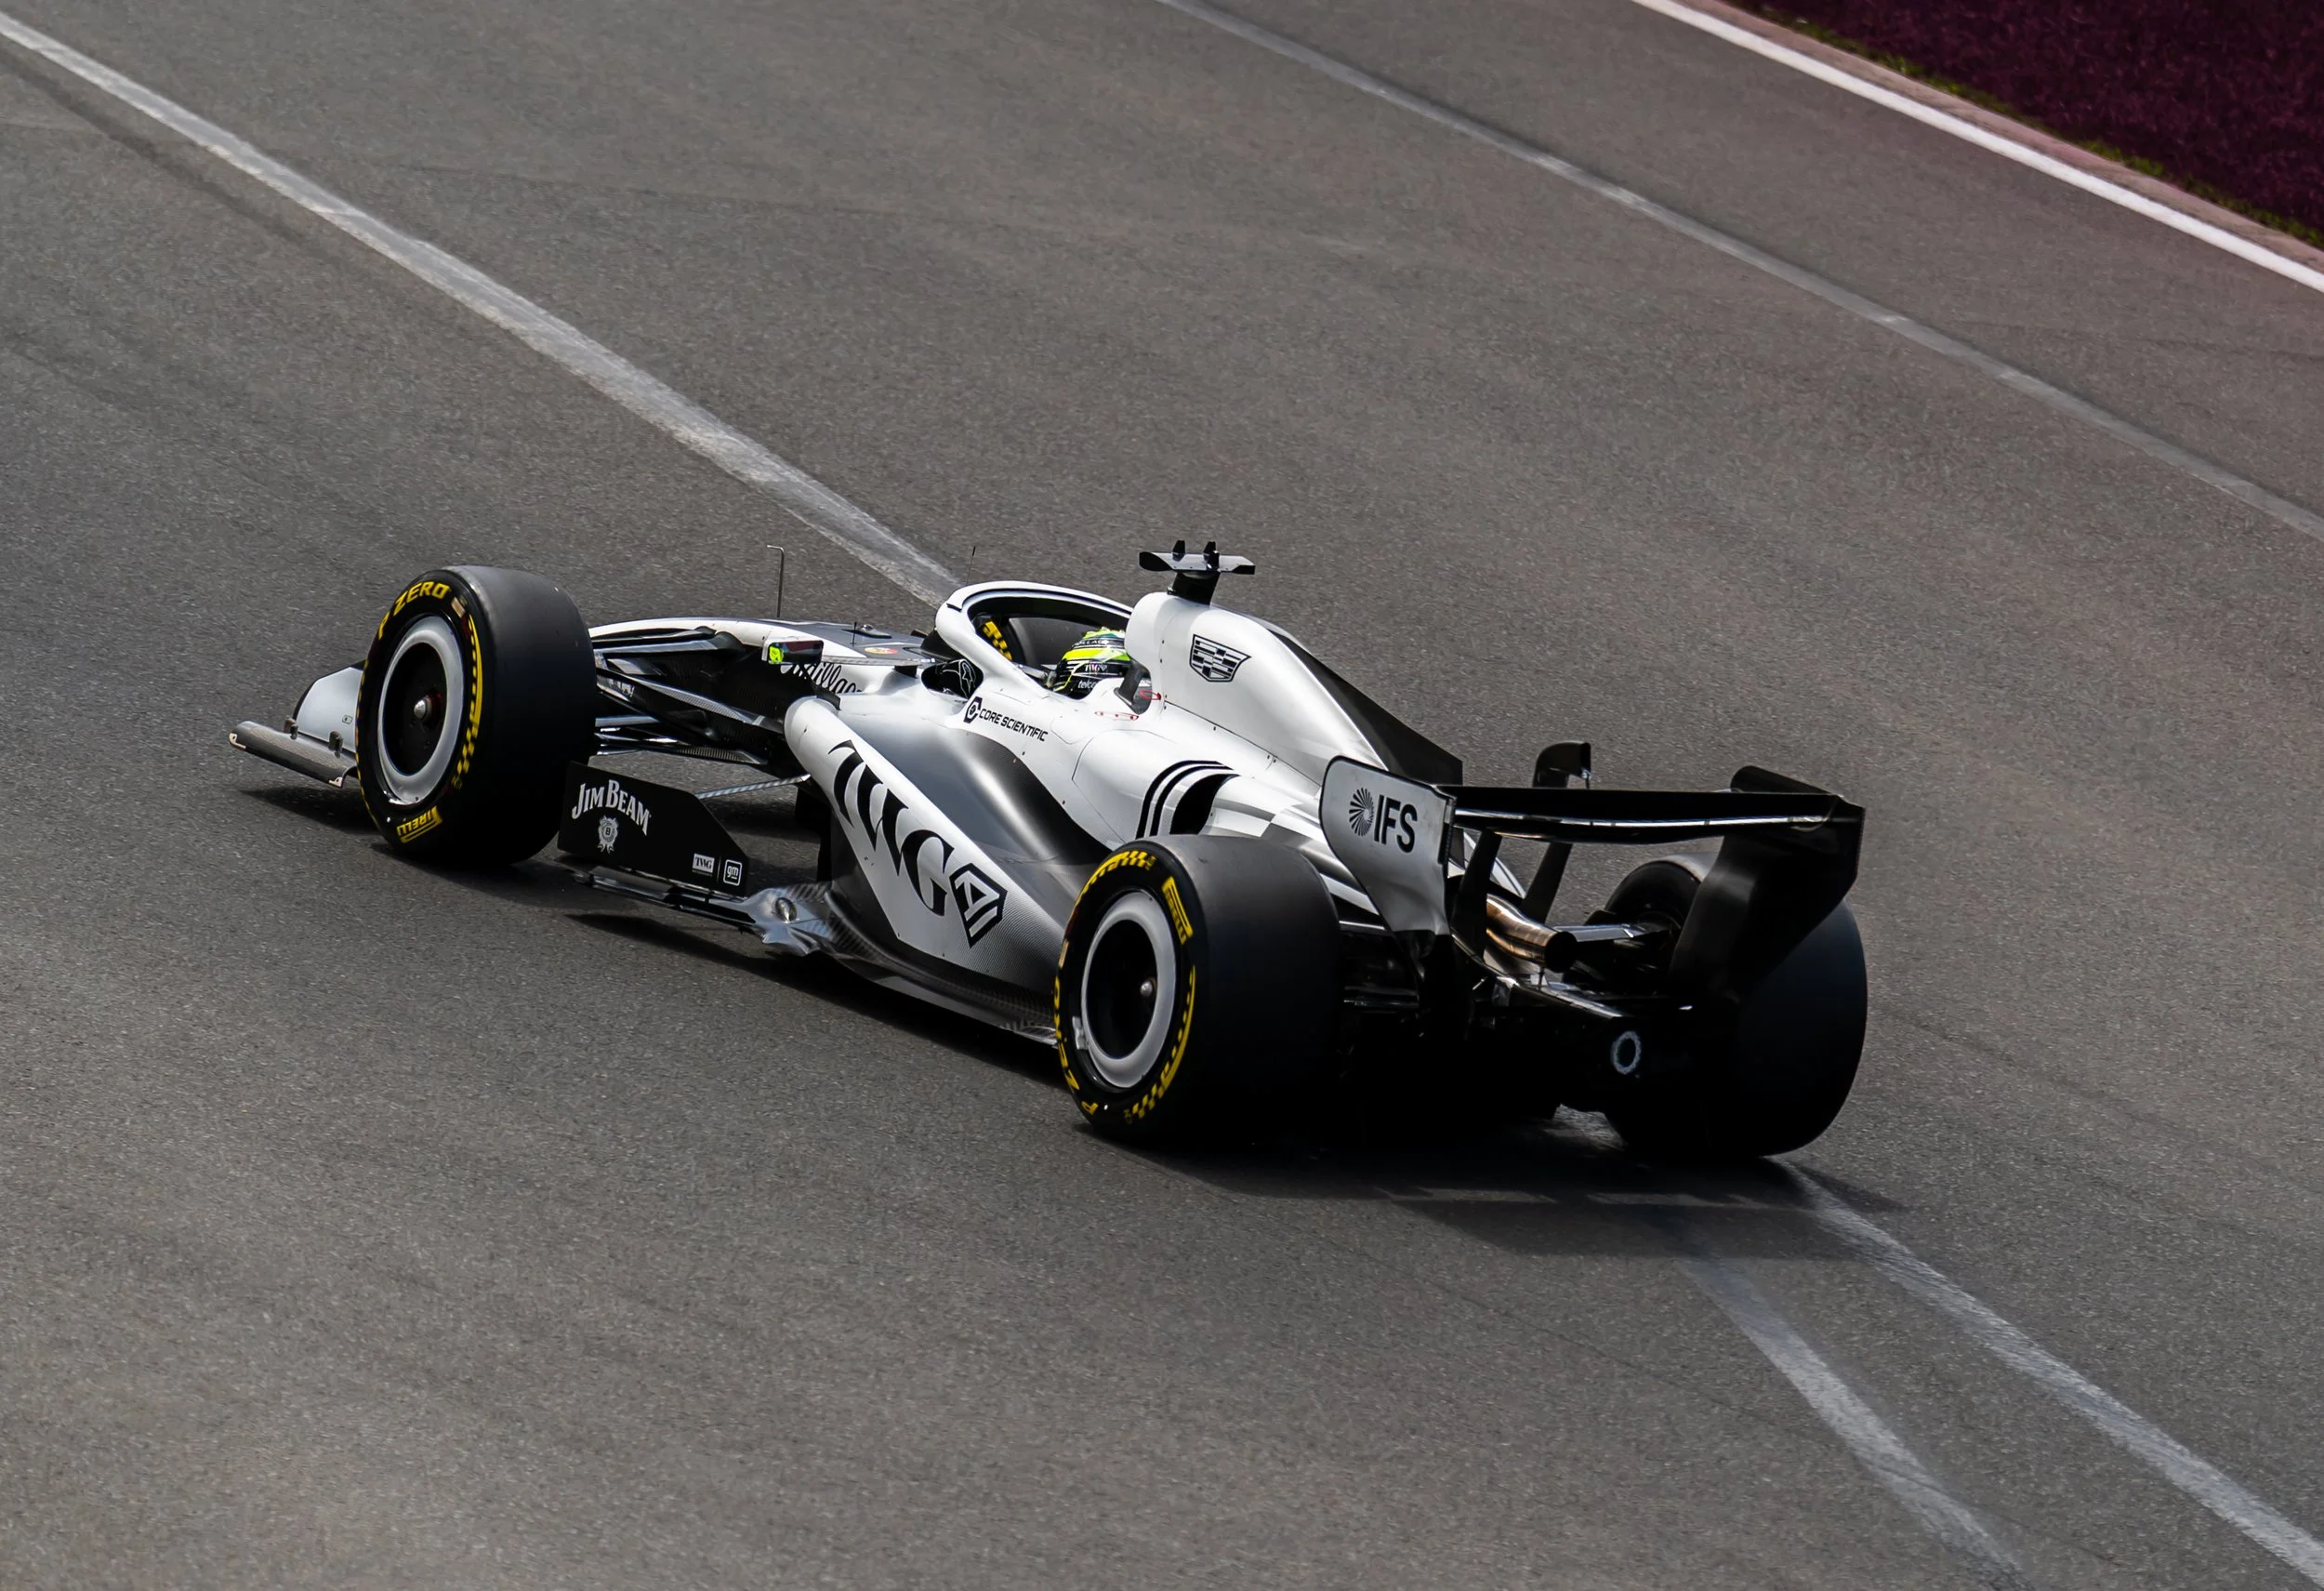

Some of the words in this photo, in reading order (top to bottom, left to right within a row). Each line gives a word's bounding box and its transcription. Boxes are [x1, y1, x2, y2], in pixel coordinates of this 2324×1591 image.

[392, 581, 451, 617] ZERO
[979, 709, 1002, 724] CORE
[1000, 716, 1049, 742] SCIENTIFIC
[396, 805, 442, 843] PIRELLI
[572, 783, 605, 819] JIM
[605, 779, 650, 836] BEAM
[1374, 794, 1418, 853] IFS
[827, 739, 955, 917] TWG
[694, 856, 712, 869] TWG
[727, 866, 739, 878] gm
